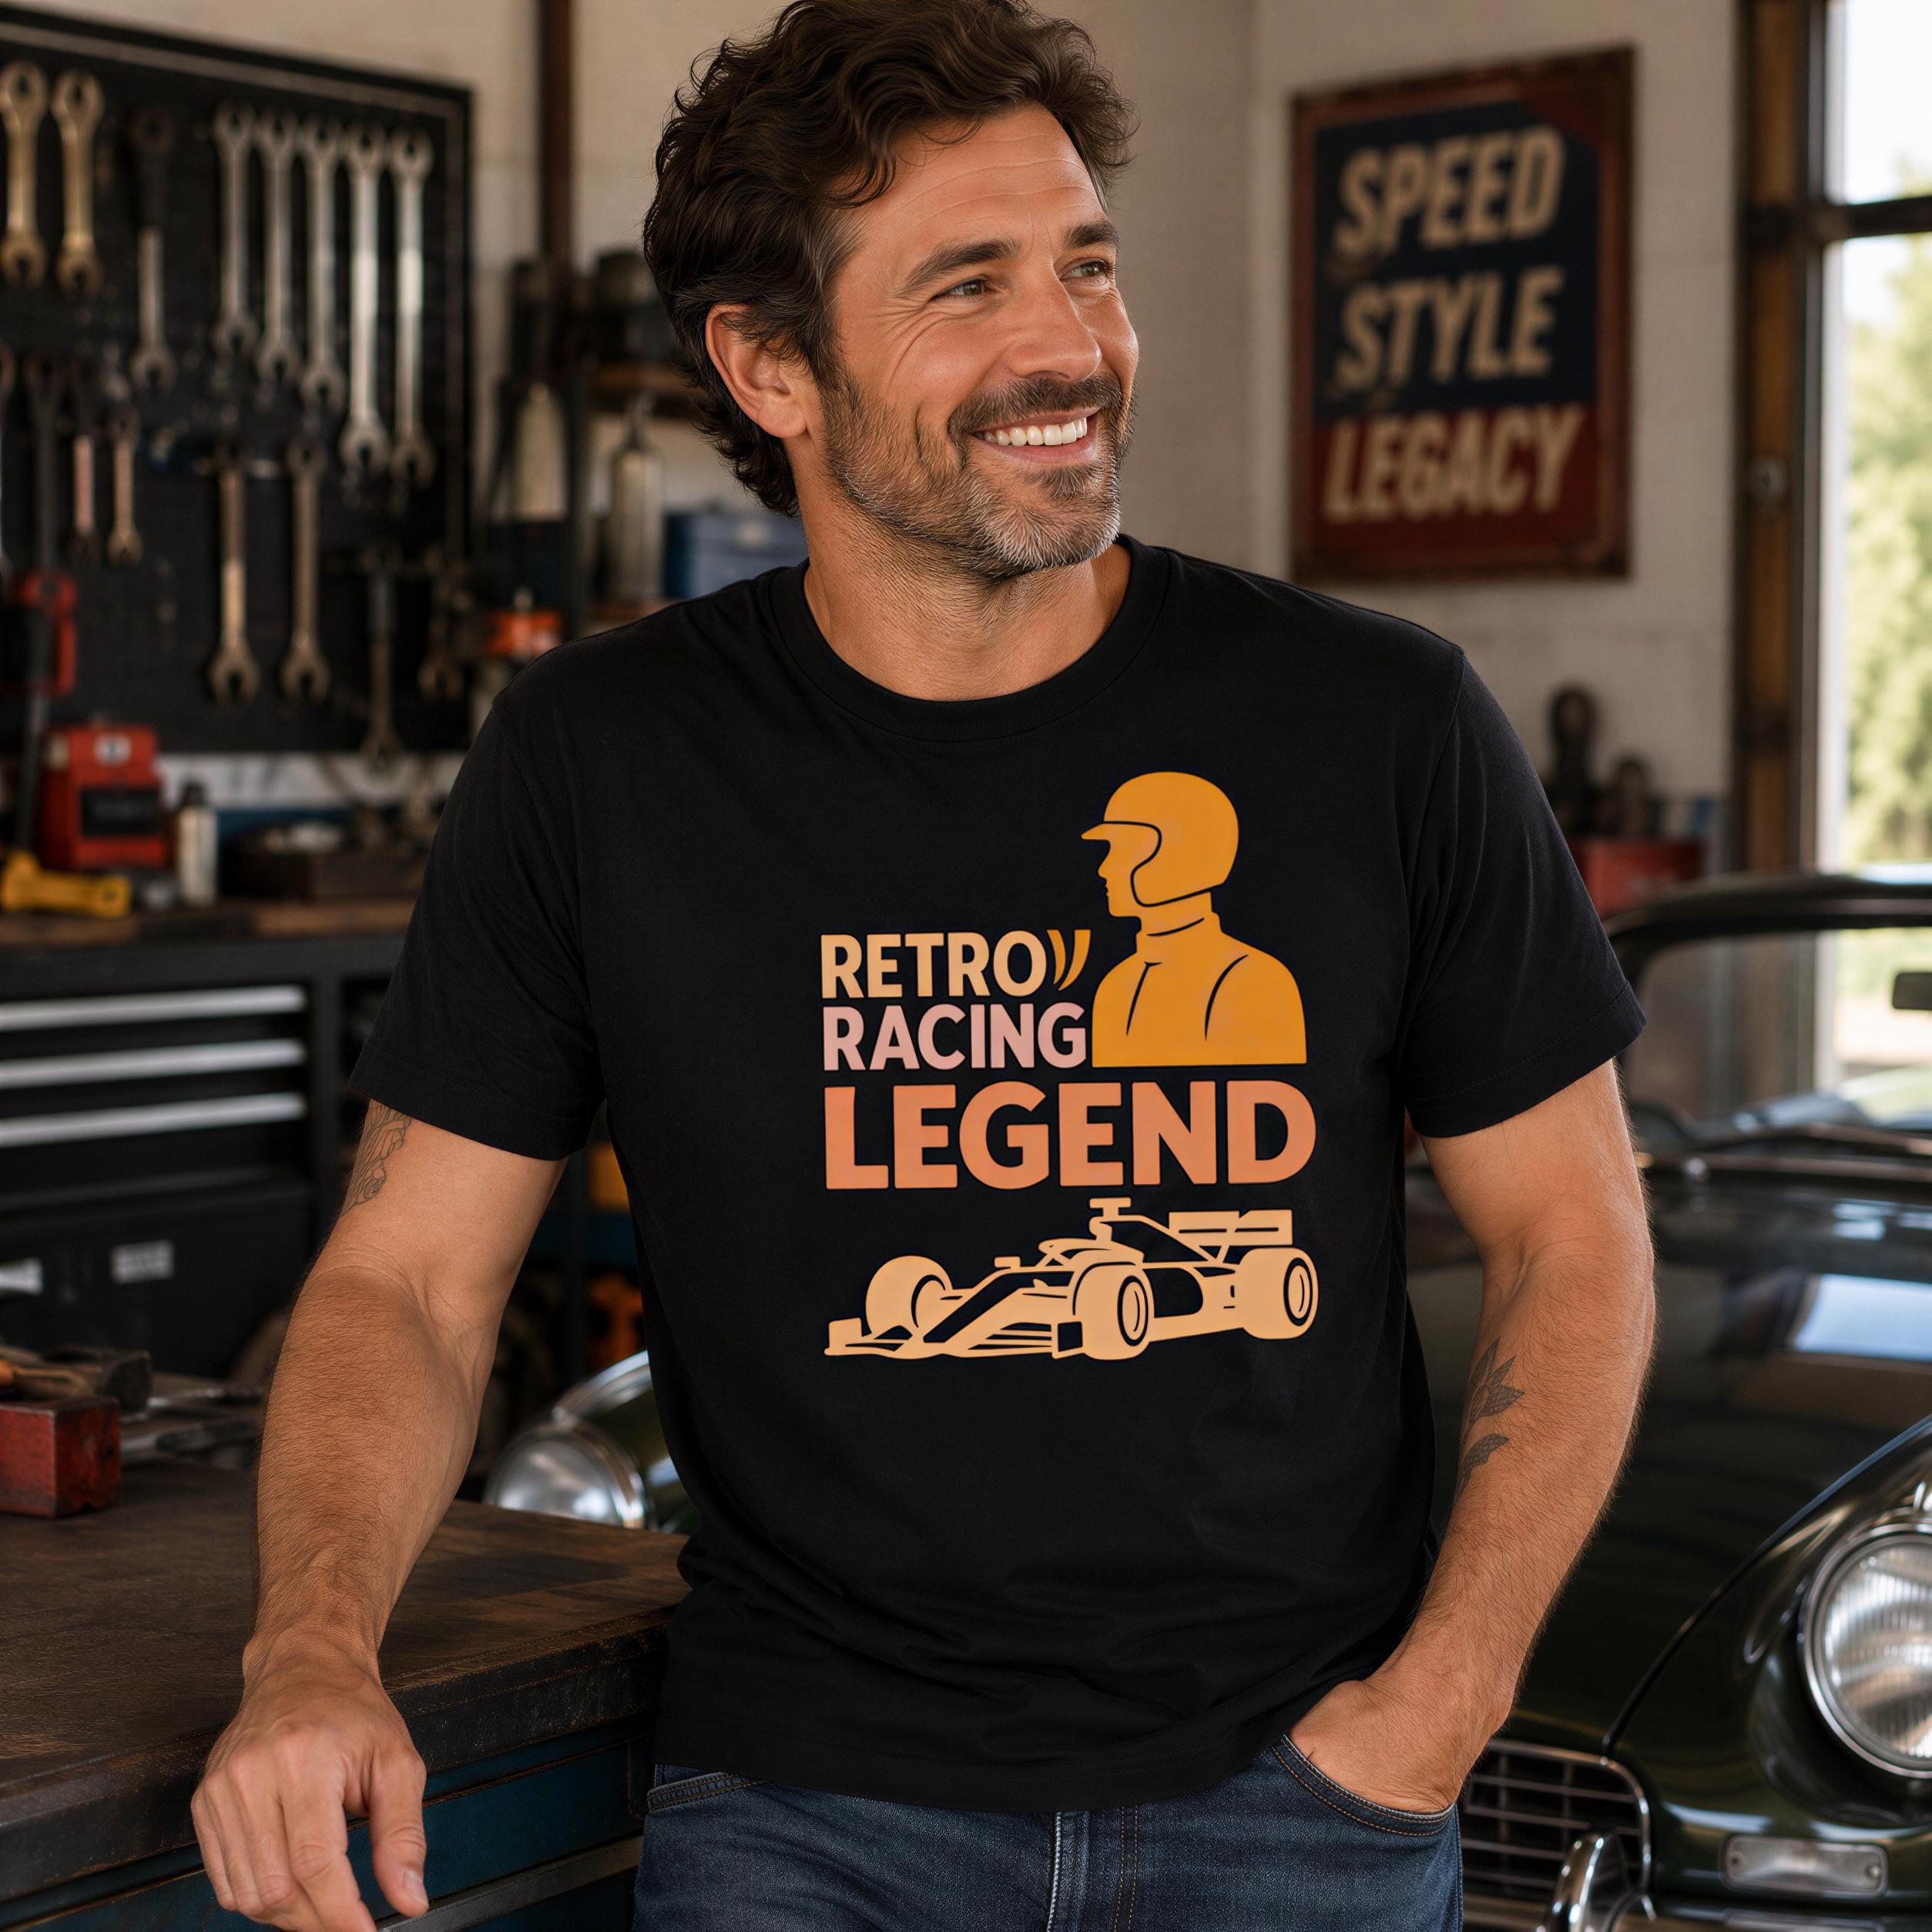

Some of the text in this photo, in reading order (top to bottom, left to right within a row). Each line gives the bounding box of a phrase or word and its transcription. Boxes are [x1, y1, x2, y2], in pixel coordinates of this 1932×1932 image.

[1334, 127, 1565, 256] SPEED
[1337, 267, 1564, 393] STYLE
[1324, 404, 1583, 522] LEGACY
[821, 930, 1047, 999] RETRO
[823, 1002, 1087, 1072] RACING
[824, 1081, 1317, 1190] LEGEND
